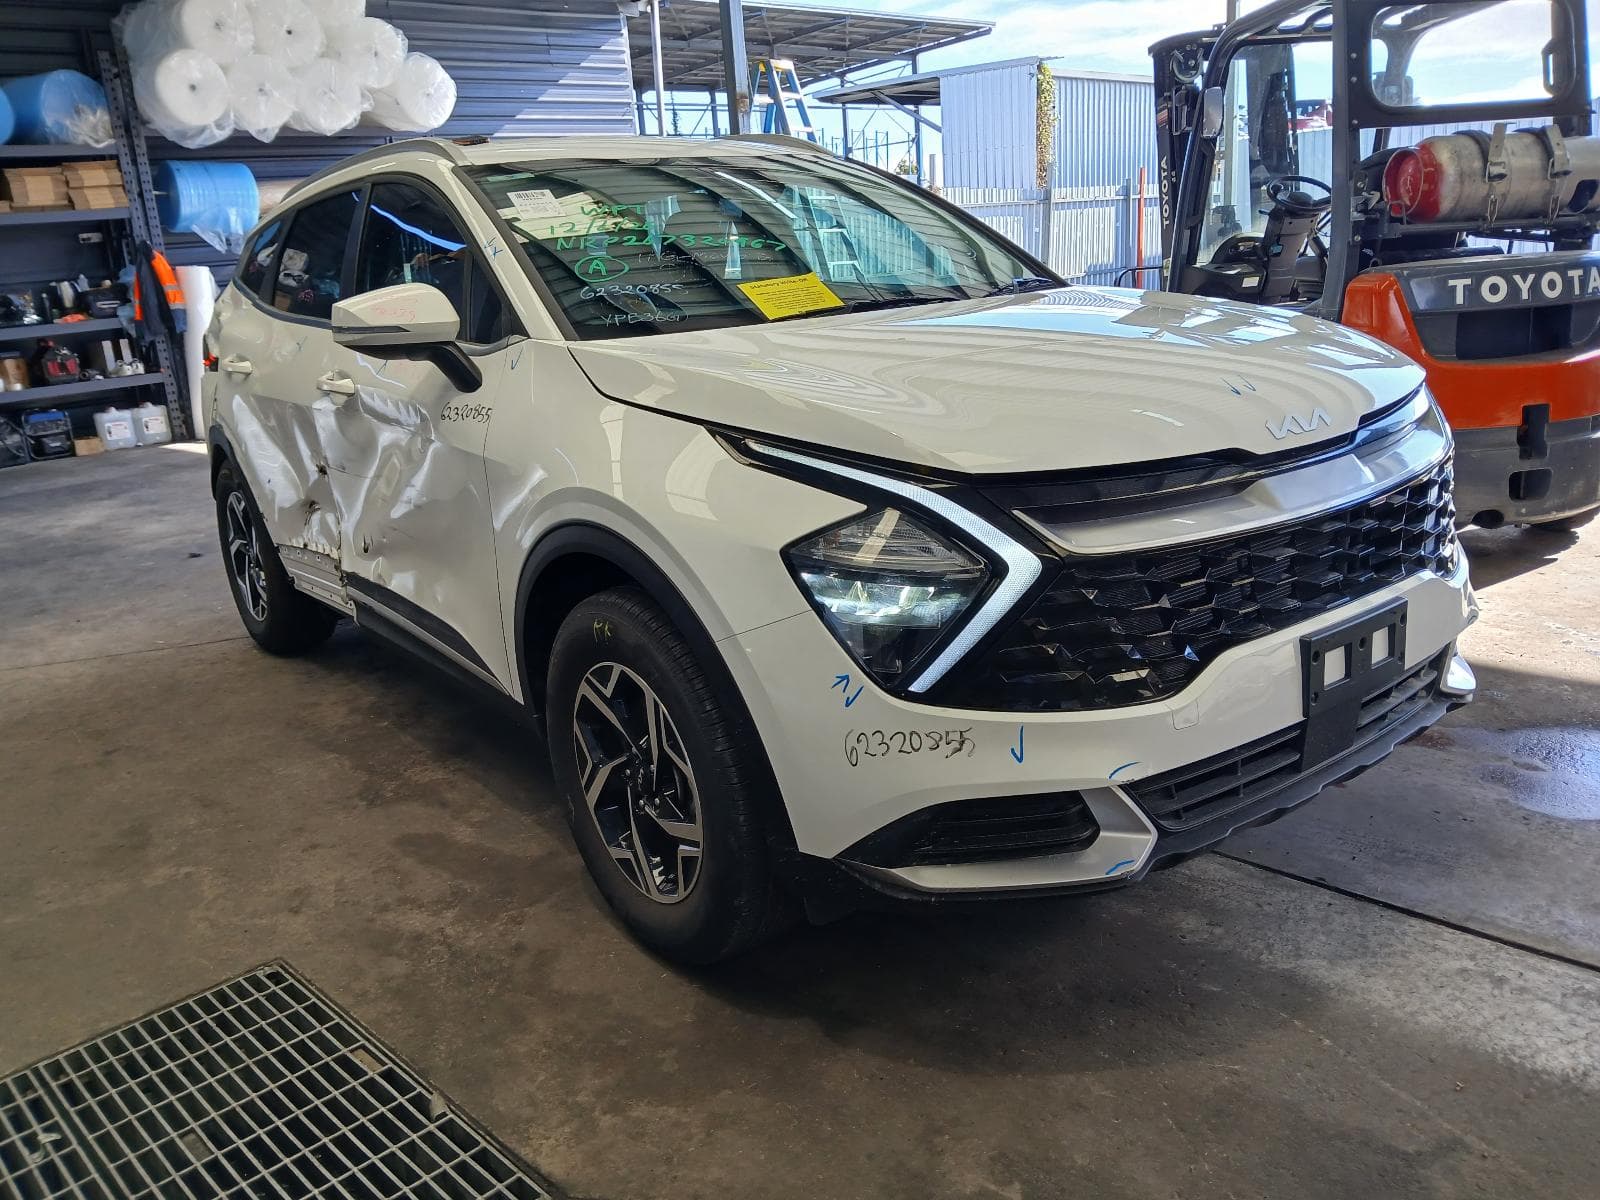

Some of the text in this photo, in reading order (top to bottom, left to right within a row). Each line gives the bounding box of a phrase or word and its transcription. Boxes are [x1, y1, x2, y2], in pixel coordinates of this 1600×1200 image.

[1160, 155, 1170, 230] TOYOTA
[580, 283, 689, 300] 62320855
[1447, 266, 1600, 306] TOYOTA
[440, 401, 493, 424] 62320855
[1264, 407, 1333, 440] KIA
[844, 726, 976, 767] 62320855
